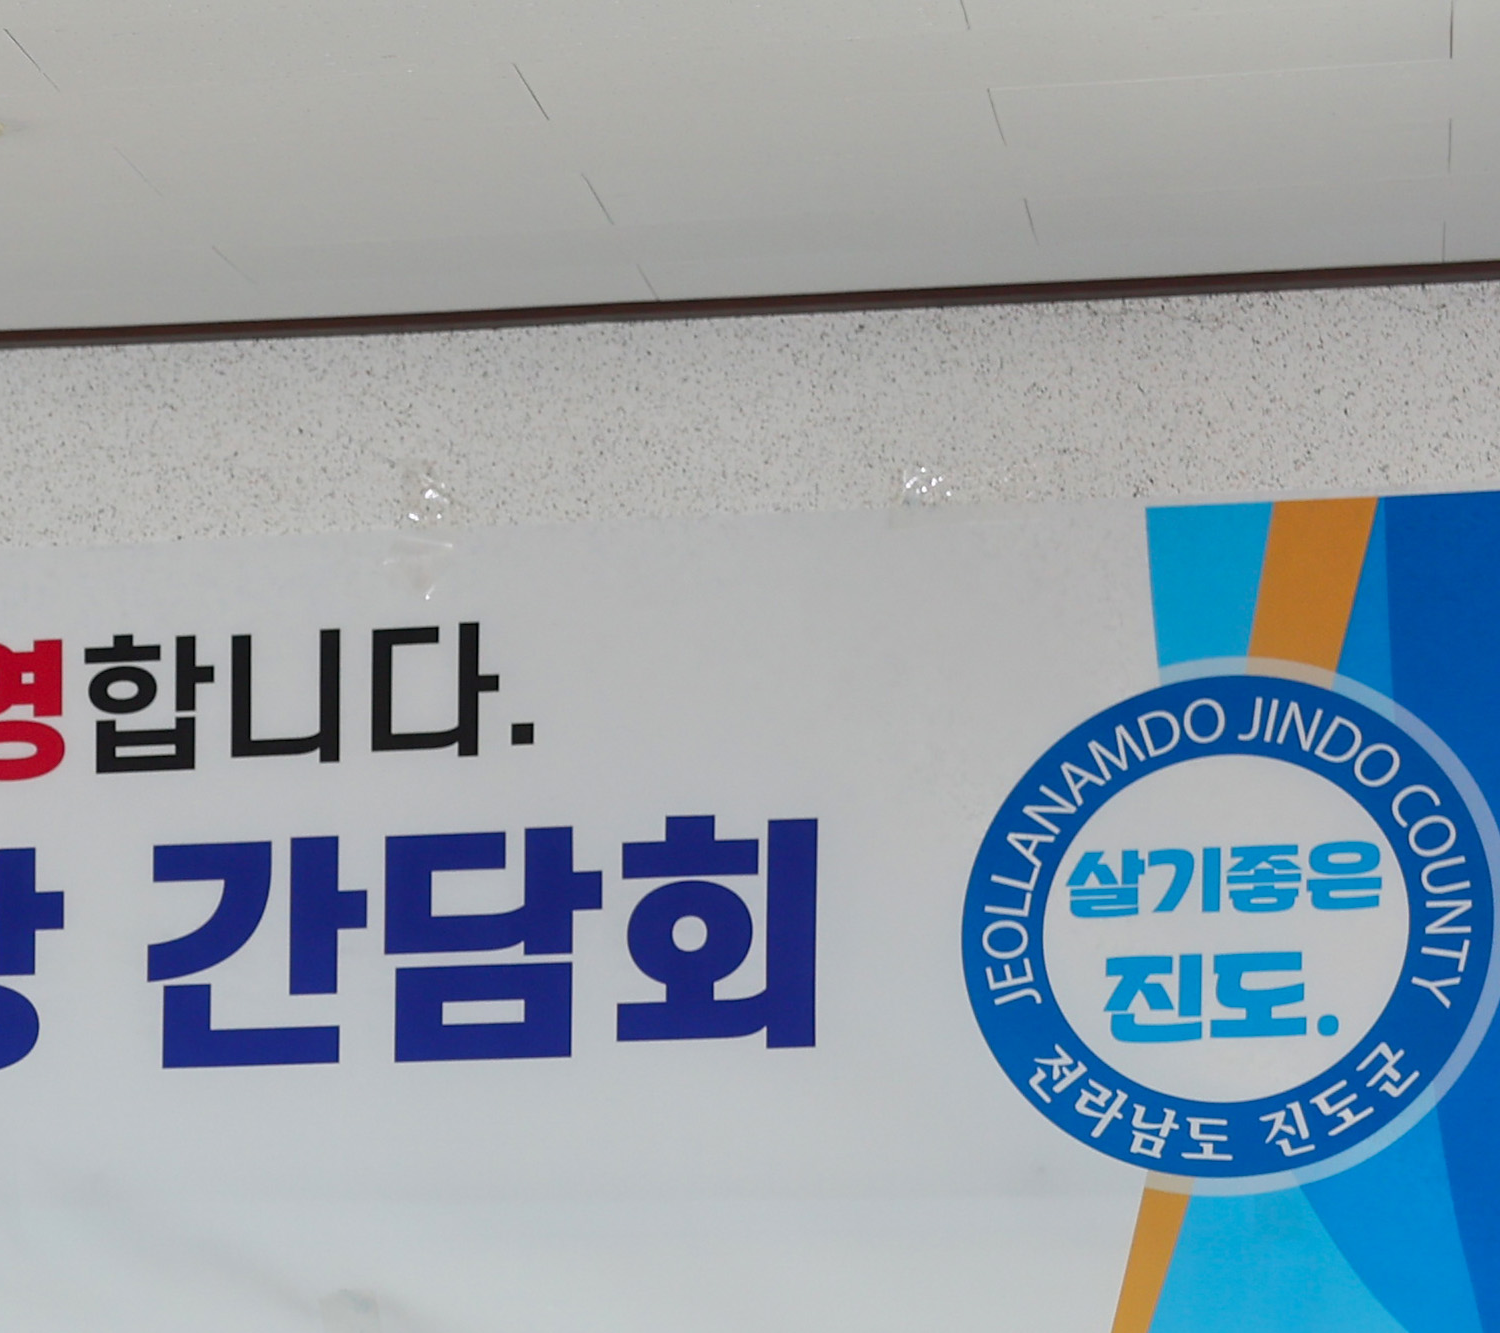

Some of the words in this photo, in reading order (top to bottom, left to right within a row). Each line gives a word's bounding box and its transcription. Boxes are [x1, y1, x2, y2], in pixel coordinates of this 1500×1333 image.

[982, 697, 1226, 1006] JEOLLANAMDO
[1237, 696, 1400, 787] JINDO
[1391, 784, 1473, 1008] COUNTY
[1065, 840, 1383, 919] 살기좋은
[147, 814, 819, 1069] 간담회
[1103, 951, 1340, 1043] 진도.
[1029, 1043, 1233, 1161] 전라남도
[1259, 1041, 1420, 1158] 진도군
